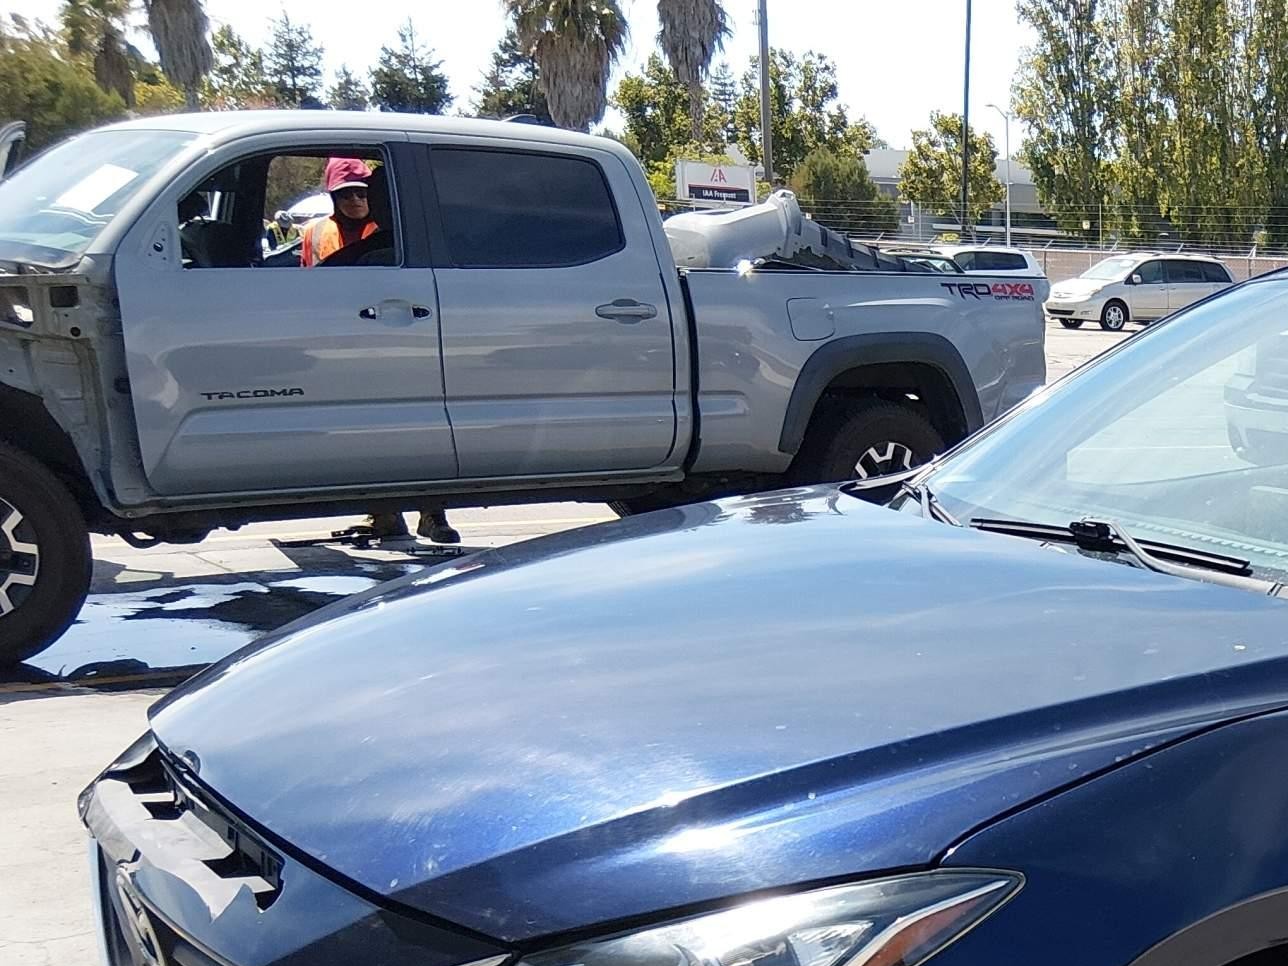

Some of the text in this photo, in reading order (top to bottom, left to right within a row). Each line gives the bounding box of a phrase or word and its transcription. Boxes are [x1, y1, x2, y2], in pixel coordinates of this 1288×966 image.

[702, 189, 714, 197] IAA
[941, 283, 992, 300] TRD
[199, 387, 304, 400] TACOMA
